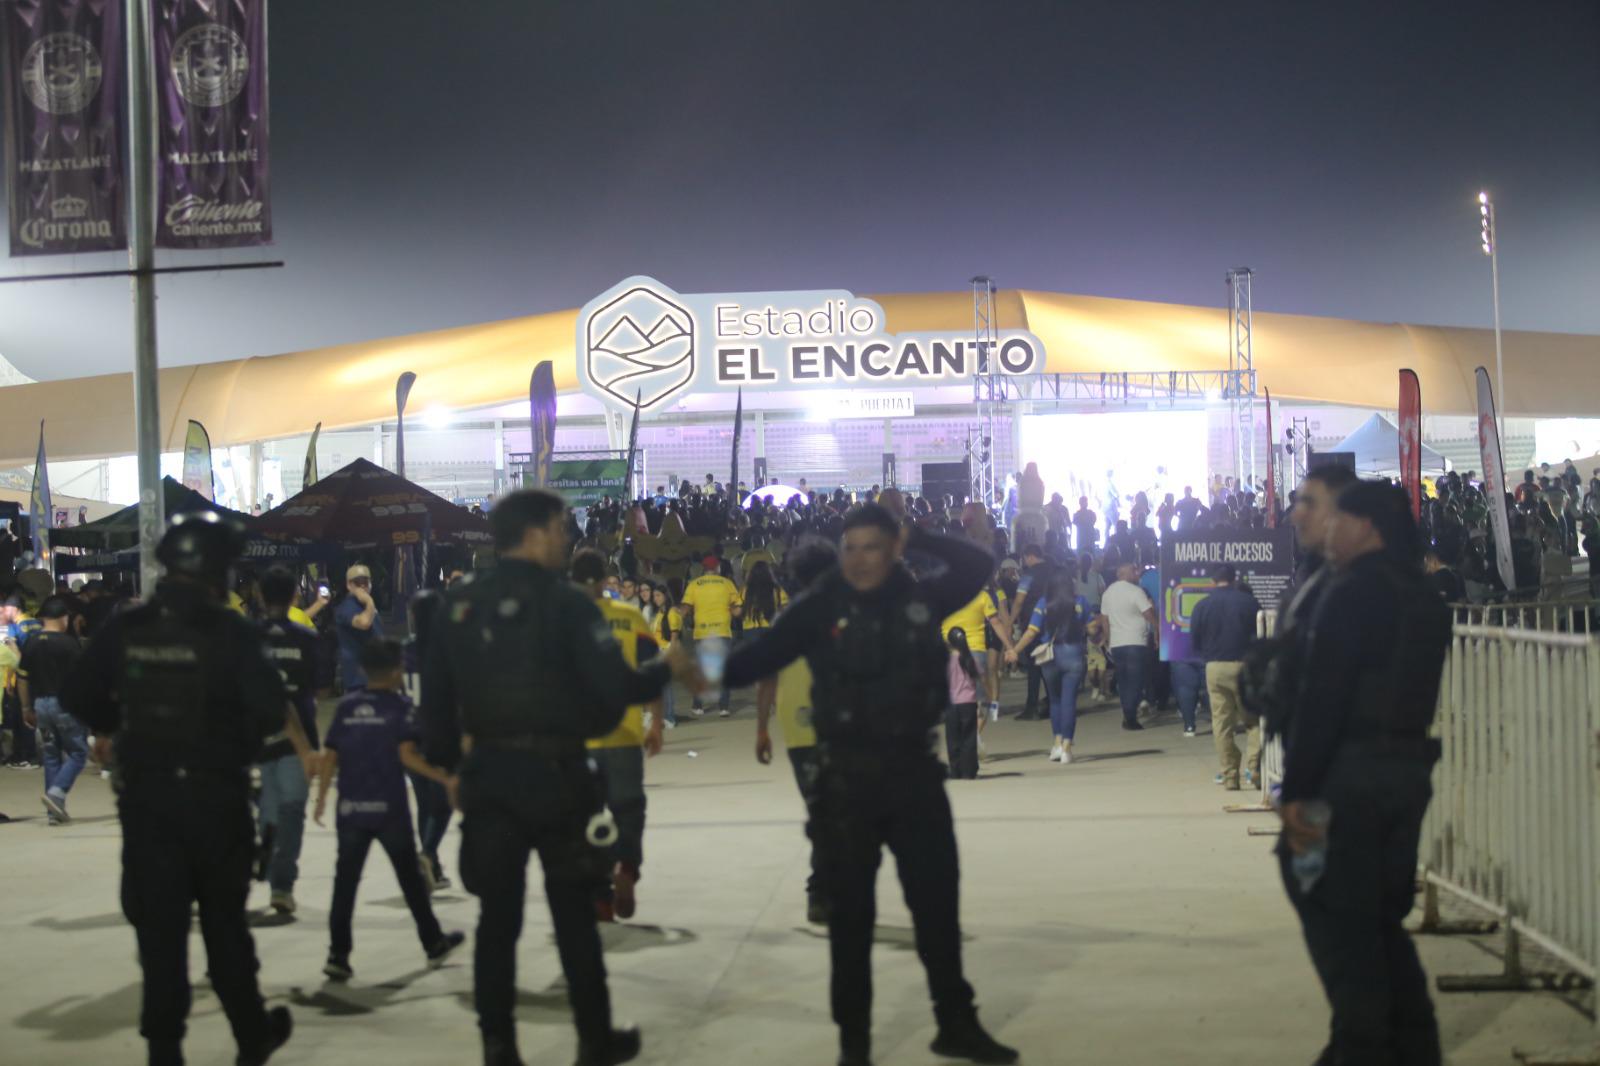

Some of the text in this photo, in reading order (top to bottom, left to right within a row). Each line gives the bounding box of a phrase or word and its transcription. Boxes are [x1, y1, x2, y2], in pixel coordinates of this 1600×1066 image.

[20, 218, 112, 247] Corona
[172, 222, 262, 236] caliente.mx
[717, 301, 874, 336] Estadio
[718, 338, 1034, 381] EL ENCANTO
[1175, 542, 1273, 562] MAPA DE ACCESOS
